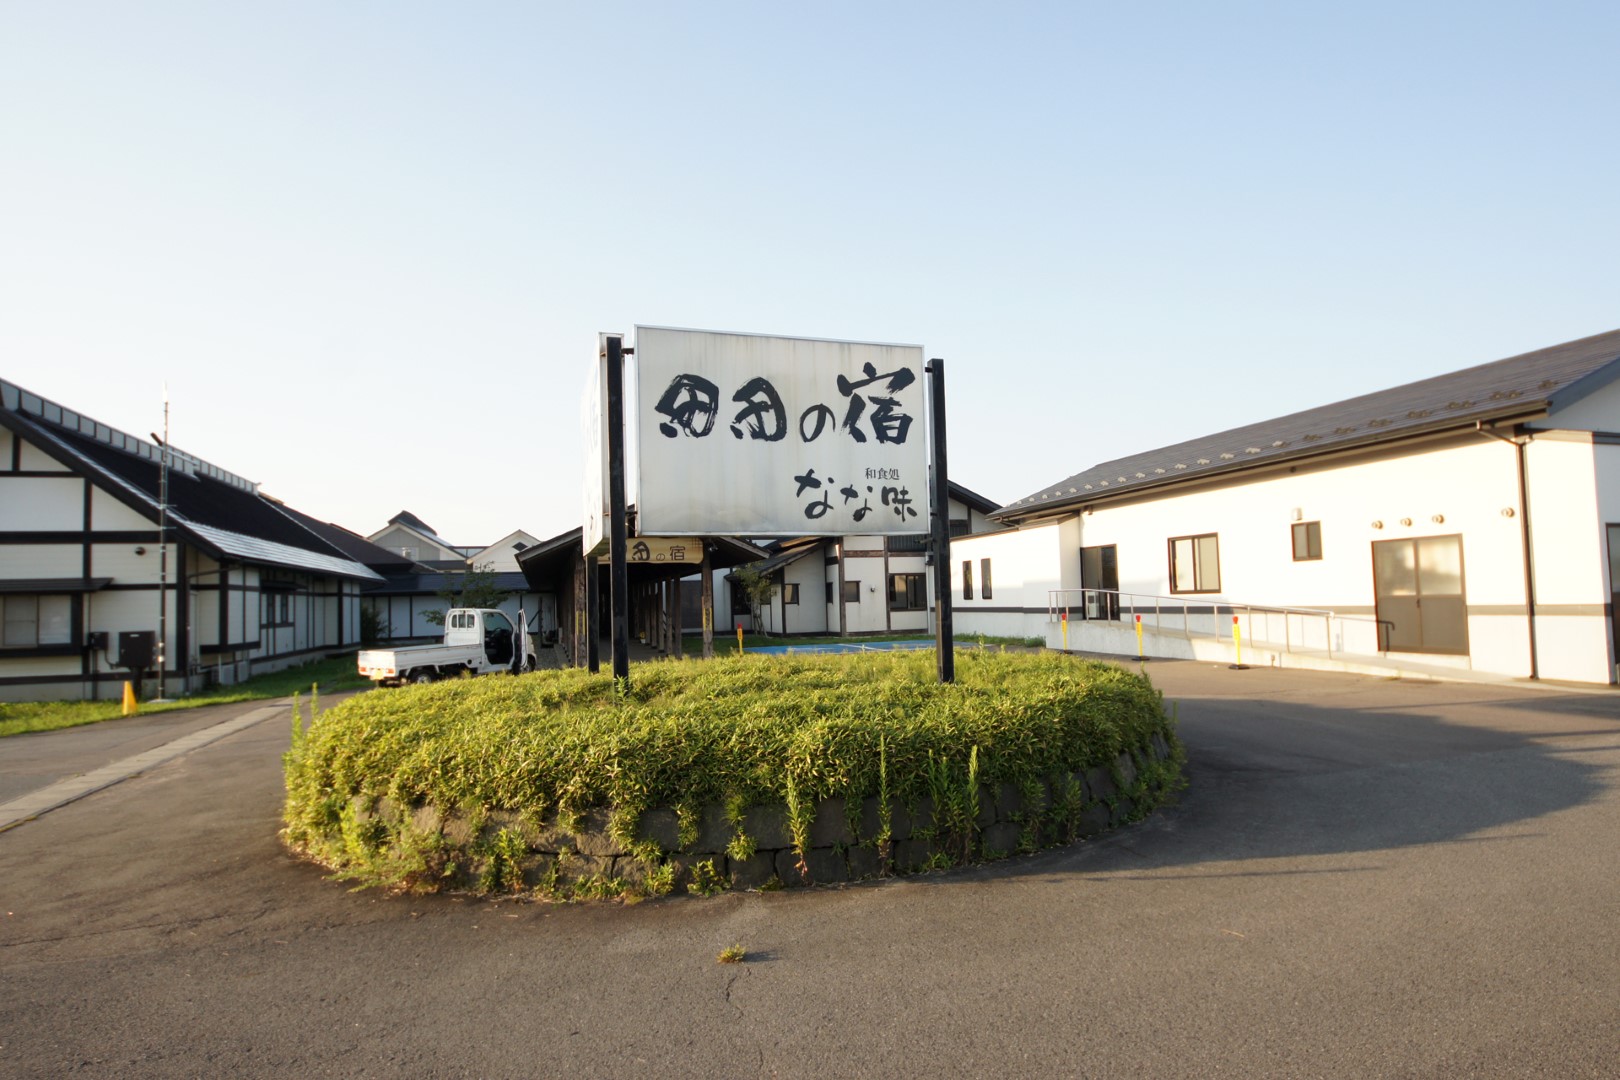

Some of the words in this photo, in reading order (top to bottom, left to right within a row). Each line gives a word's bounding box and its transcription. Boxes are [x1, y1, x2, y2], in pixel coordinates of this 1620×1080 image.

[865, 467, 900, 481] 和食処
[794, 468, 918, 523] なな味
